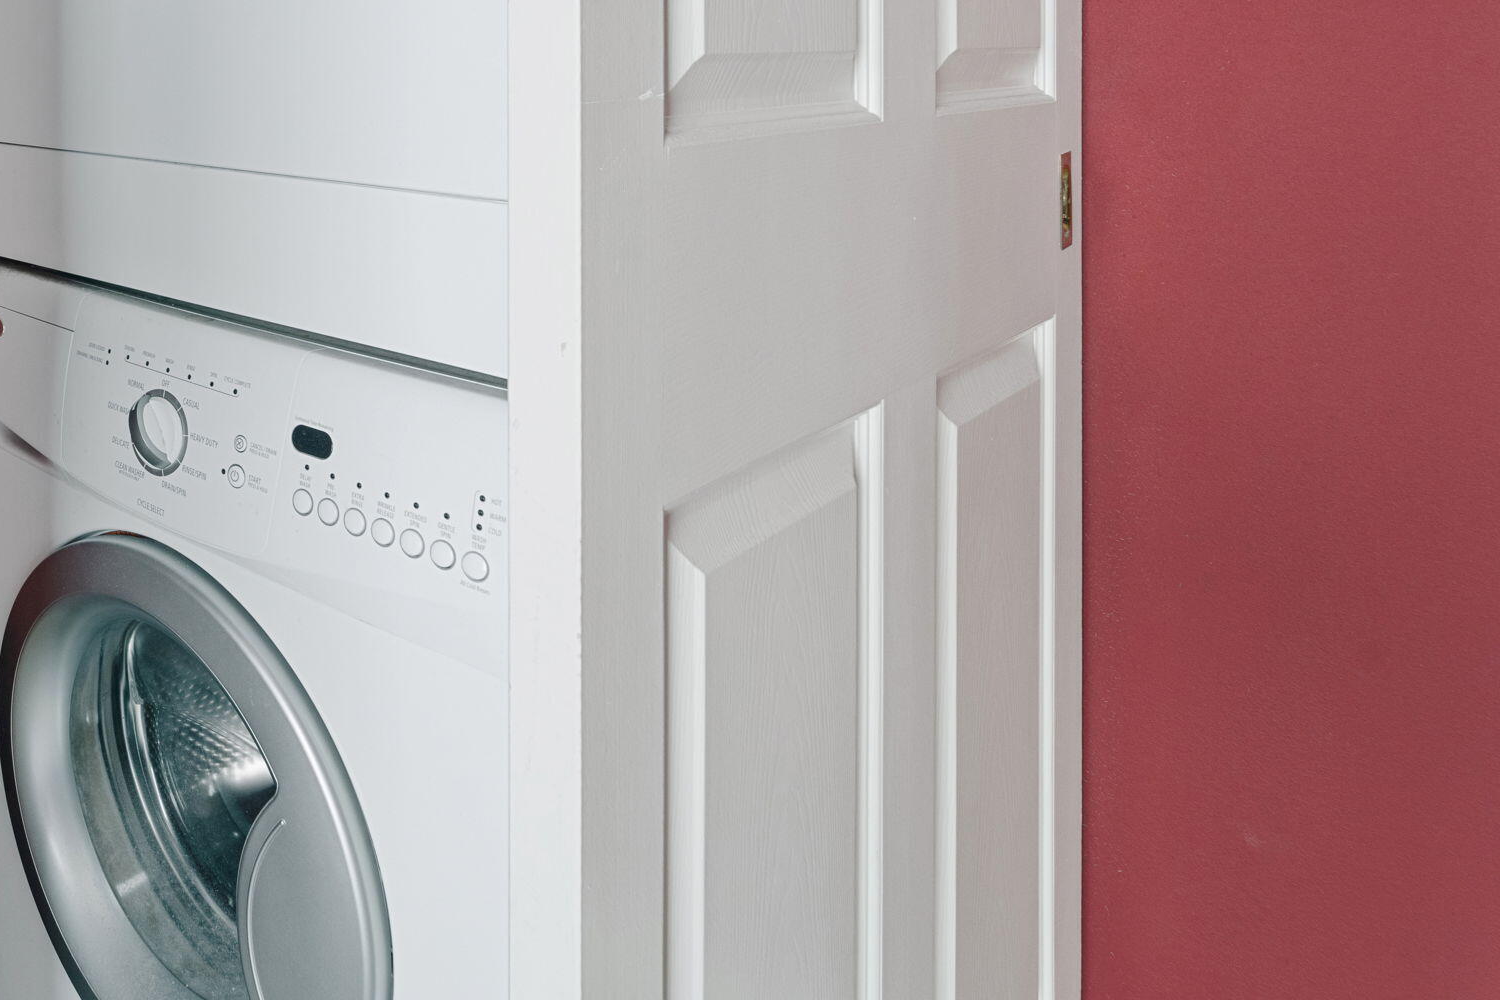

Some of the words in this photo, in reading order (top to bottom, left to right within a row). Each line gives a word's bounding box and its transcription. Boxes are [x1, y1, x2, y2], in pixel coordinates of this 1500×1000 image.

[182, 397, 200, 410] CASUAL
[190, 432, 204, 443] HEAVY
[204, 437, 219, 448] DUTY
